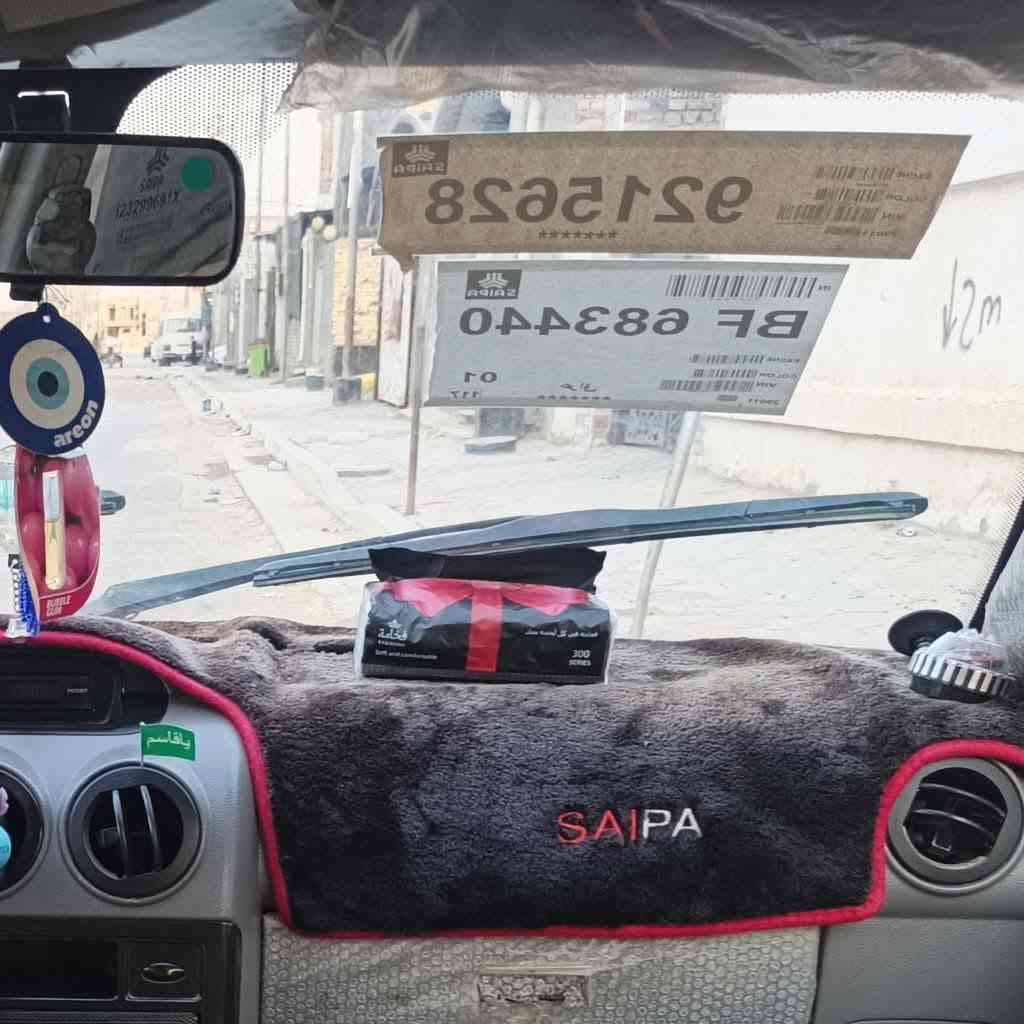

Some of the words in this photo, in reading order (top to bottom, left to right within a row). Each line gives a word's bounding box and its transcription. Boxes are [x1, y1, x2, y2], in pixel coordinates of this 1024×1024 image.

[53, 400, 99, 448] areon
[571, 649, 591, 658] 300
[553, 808, 702, 844] SAIPA
